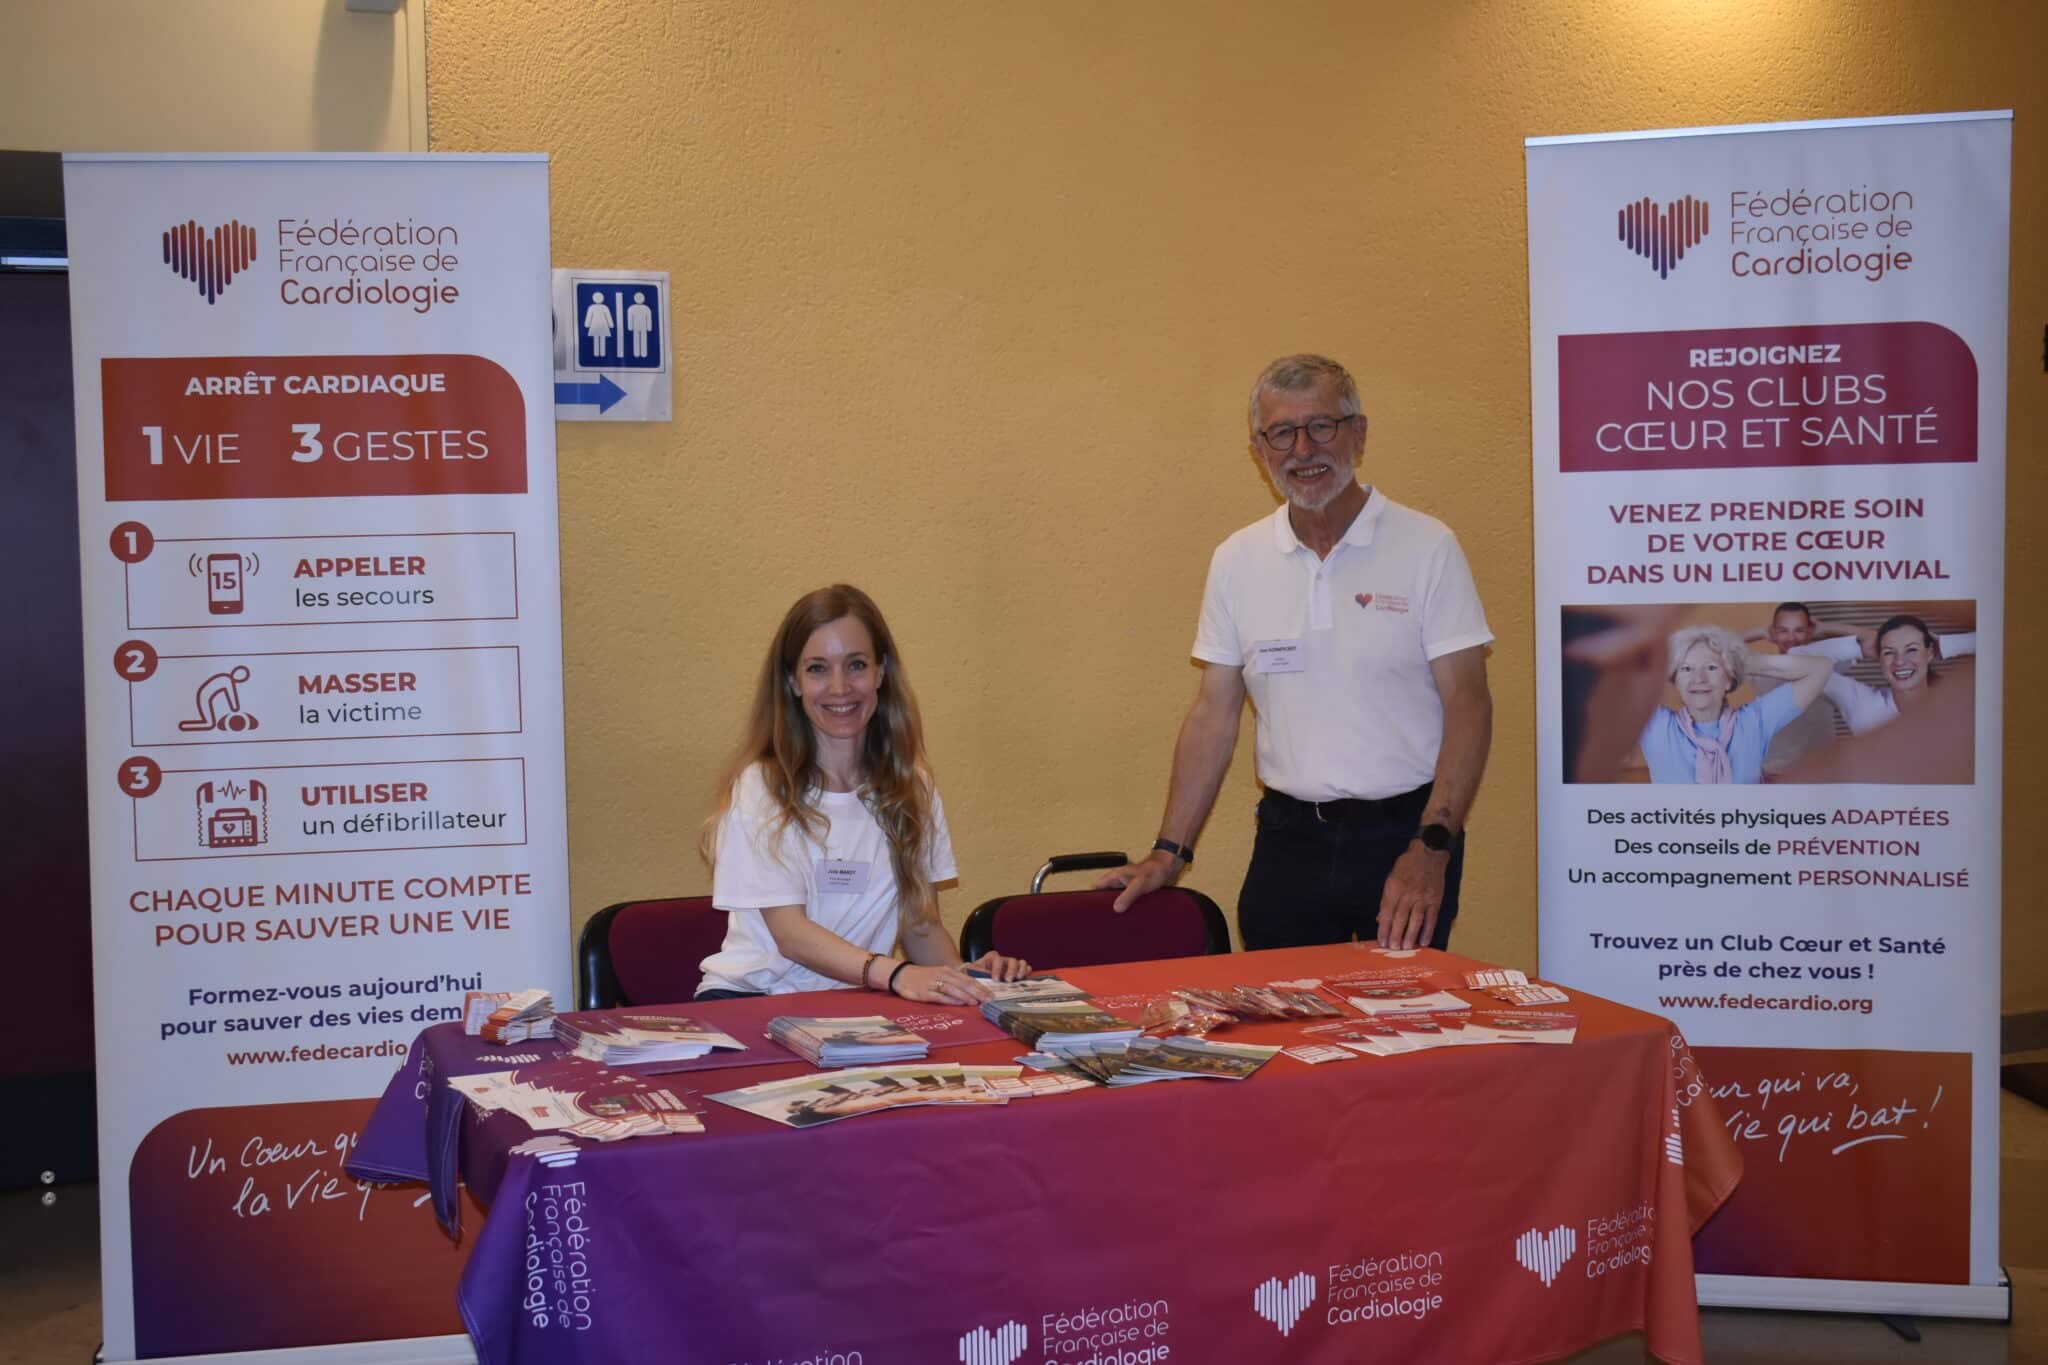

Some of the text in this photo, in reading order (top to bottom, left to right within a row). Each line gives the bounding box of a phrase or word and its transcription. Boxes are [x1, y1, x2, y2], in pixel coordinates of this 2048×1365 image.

[1730, 184, 1914, 218] Fédération
[277, 218, 458, 247] Fédération
[1730, 214, 1913, 247] Française de
[278, 248, 459, 275] Française de
[1731, 244, 1913, 281] Cardiologie
[280, 278, 460, 314] Cardiologie
[1688, 344, 1842, 368] REJOIGNEZ
[184, 371, 446, 398] ARRÊT CARDIAQUE
[1646, 373, 1888, 411] NOS CLUBS
[291, 423, 490, 462] 3 GESTES
[1595, 406, 1939, 453] CŒUR ET SANTÉ
[142, 425, 241, 465] 1 VIE
[1608, 497, 1925, 525] VENEZ PRENDRE SOIN
[125, 530, 139, 555] 1
[1647, 530, 1886, 553] DE VOTRE CŒUR
[212, 571, 237, 591] 15
[293, 556, 427, 578] APPELER
[1586, 559, 1951, 585] DANS UN LIEU CONVIVIAL
[295, 586, 435, 607] les secours
[125, 650, 147, 674] 2
[297, 672, 417, 695] MASSER
[299, 703, 423, 724] la victime
[131, 766, 150, 790] 3
[301, 782, 429, 807] UTILISER
[302, 810, 507, 837] un défibrillateur
[1586, 807, 1950, 830] Des activités physiques ADAPTÉES
[1614, 836, 1920, 857] Des conseils de PRÉVENTION
[1568, 867, 1970, 890] Un accompagnement PERSONNALISÉ
[128, 873, 533, 913] CHAQUE MINUTE COMPTE
[155, 908, 511, 947] POUR SAUVER UNE VIE
[1590, 933, 1947, 955] Trouvez un Club Cœur et Santé
[1658, 961, 1875, 982] près de chez vous !
[188, 981, 342, 1007] Formez-vous
[1659, 993, 1874, 1015] www.fedecardio.org
[160, 1003, 462, 1041] pour sauver des vies dem
[226, 1040, 408, 1067] www.fedecardio
[1757, 1071, 1806, 1111] qui
[1816, 1071, 1859, 1097] va,
[1778, 1111, 1833, 1163] qui
[1847, 1097, 1917, 1131] bat
[1922, 1085, 1944, 1130] !
[187, 1138, 226, 1179] Un
[232, 1176, 271, 1217] la
[286, 1168, 348, 1210] Vie
[541, 1184, 573, 1329] Française de
[563, 1181, 596, 1331] Fédération
[1328, 1249, 1443, 1286] Fédération
[1327, 1269, 1443, 1305] Française de
[1041, 1299, 1169, 1337] Fédération
[1326, 1293, 1444, 1326] Cardiologie
[1042, 1319, 1169, 1356] Française de
